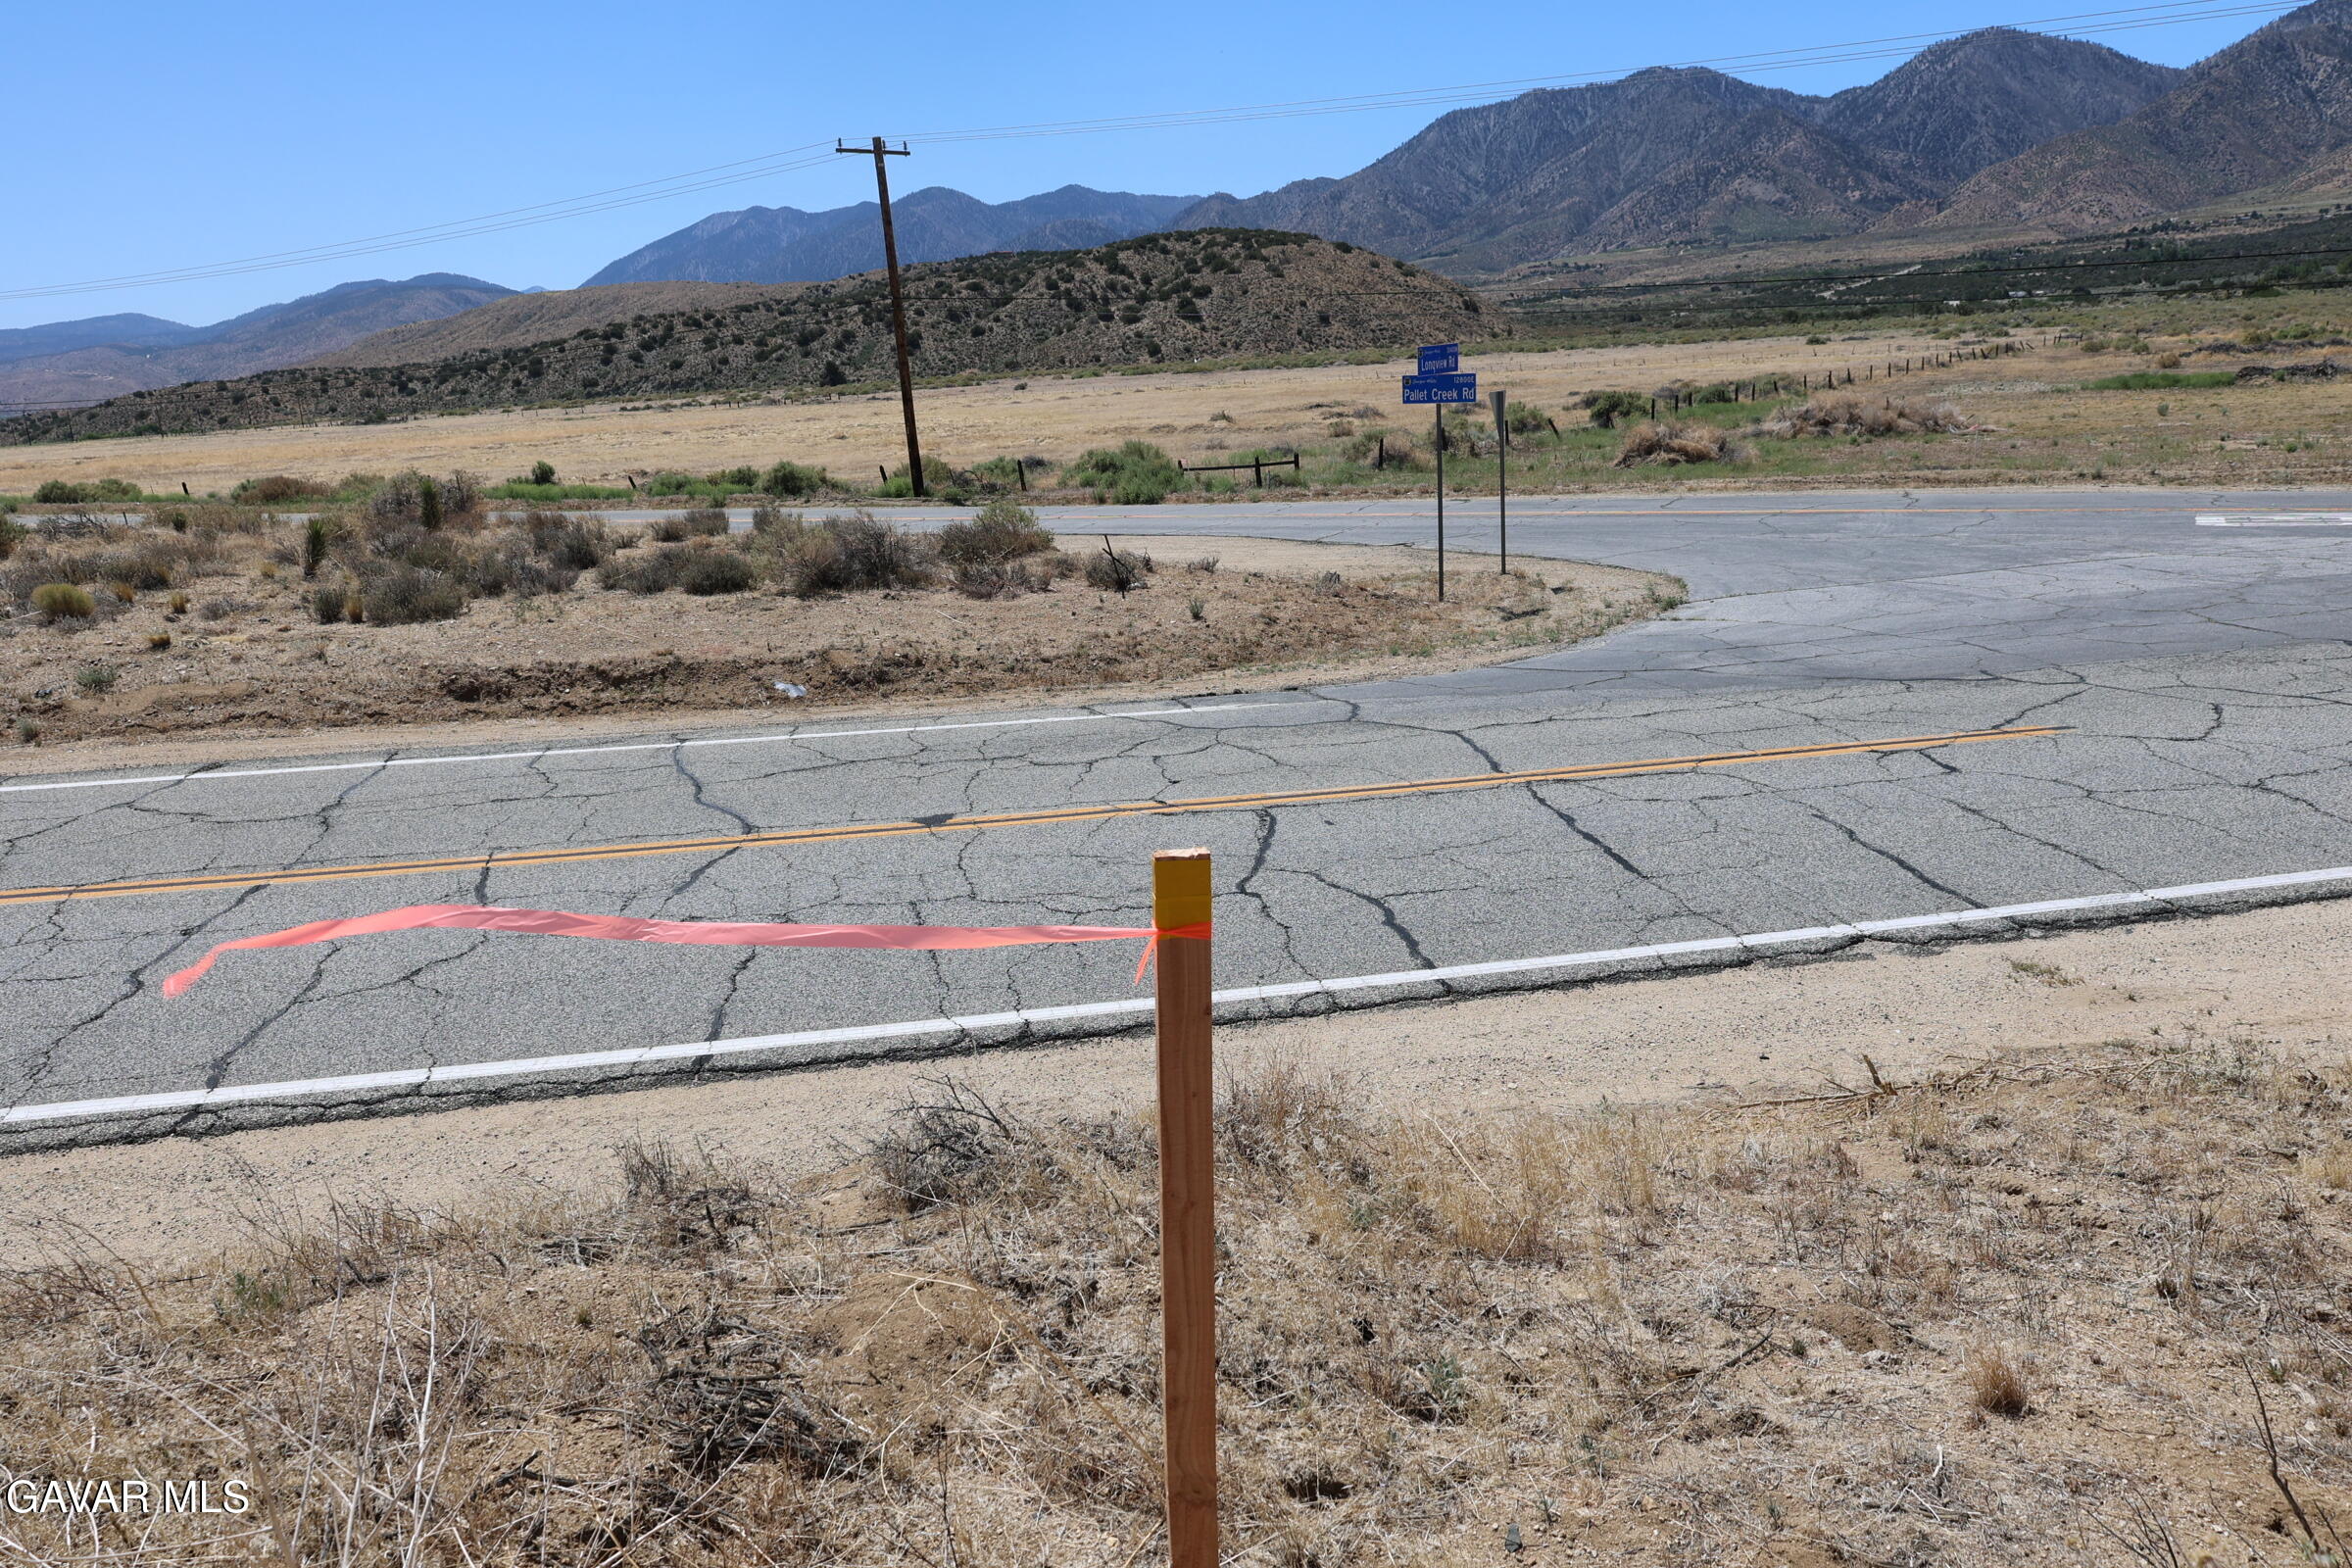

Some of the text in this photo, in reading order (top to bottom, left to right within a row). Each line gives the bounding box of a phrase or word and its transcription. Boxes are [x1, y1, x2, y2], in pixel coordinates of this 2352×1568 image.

[1421, 356, 1455, 373] Longview Rd
[1404, 387, 1474, 400] Pallet Creek Rd
